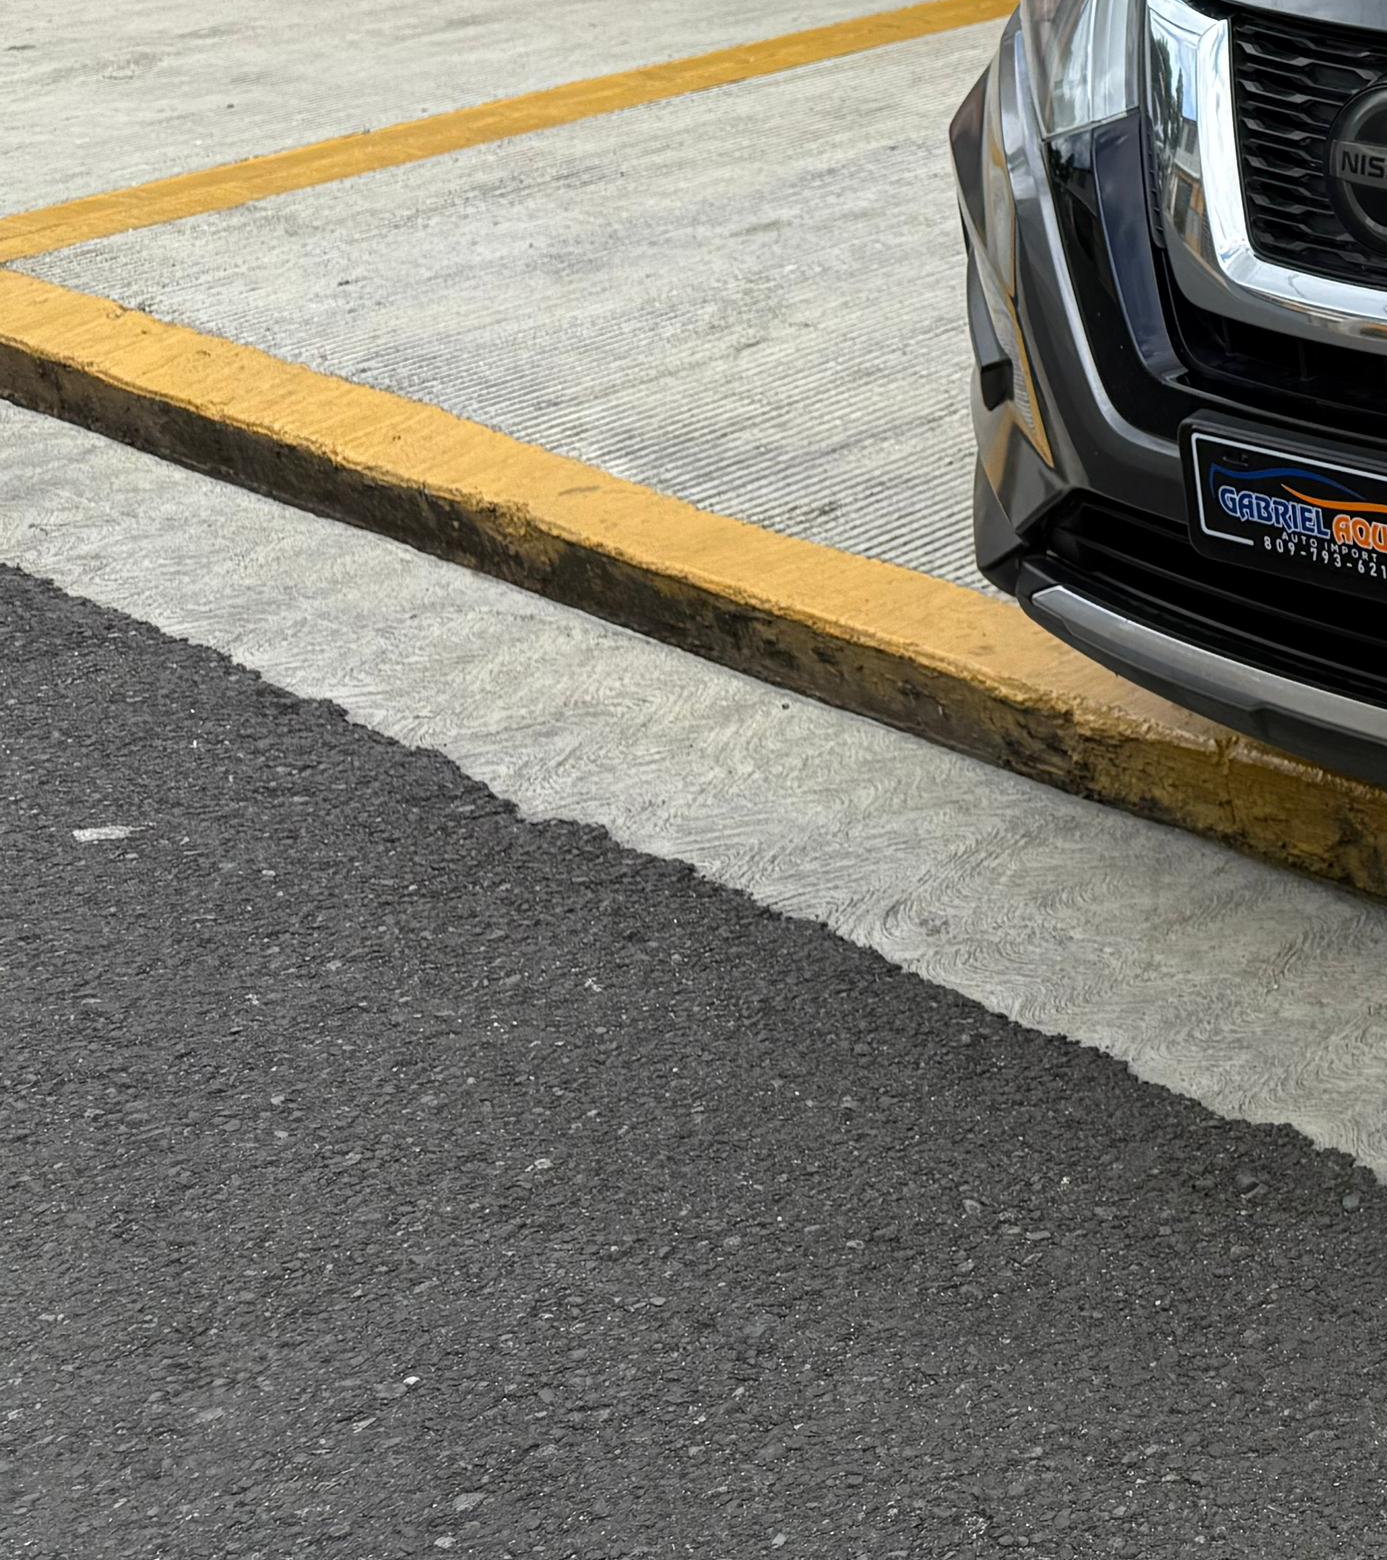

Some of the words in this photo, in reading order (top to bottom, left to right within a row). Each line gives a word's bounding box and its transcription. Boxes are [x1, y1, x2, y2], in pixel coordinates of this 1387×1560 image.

[1217, 485, 1331, 540] GABRIEL
[1281, 530, 1318, 548] AUTO
[1324, 542, 1379, 563] IMPORT
